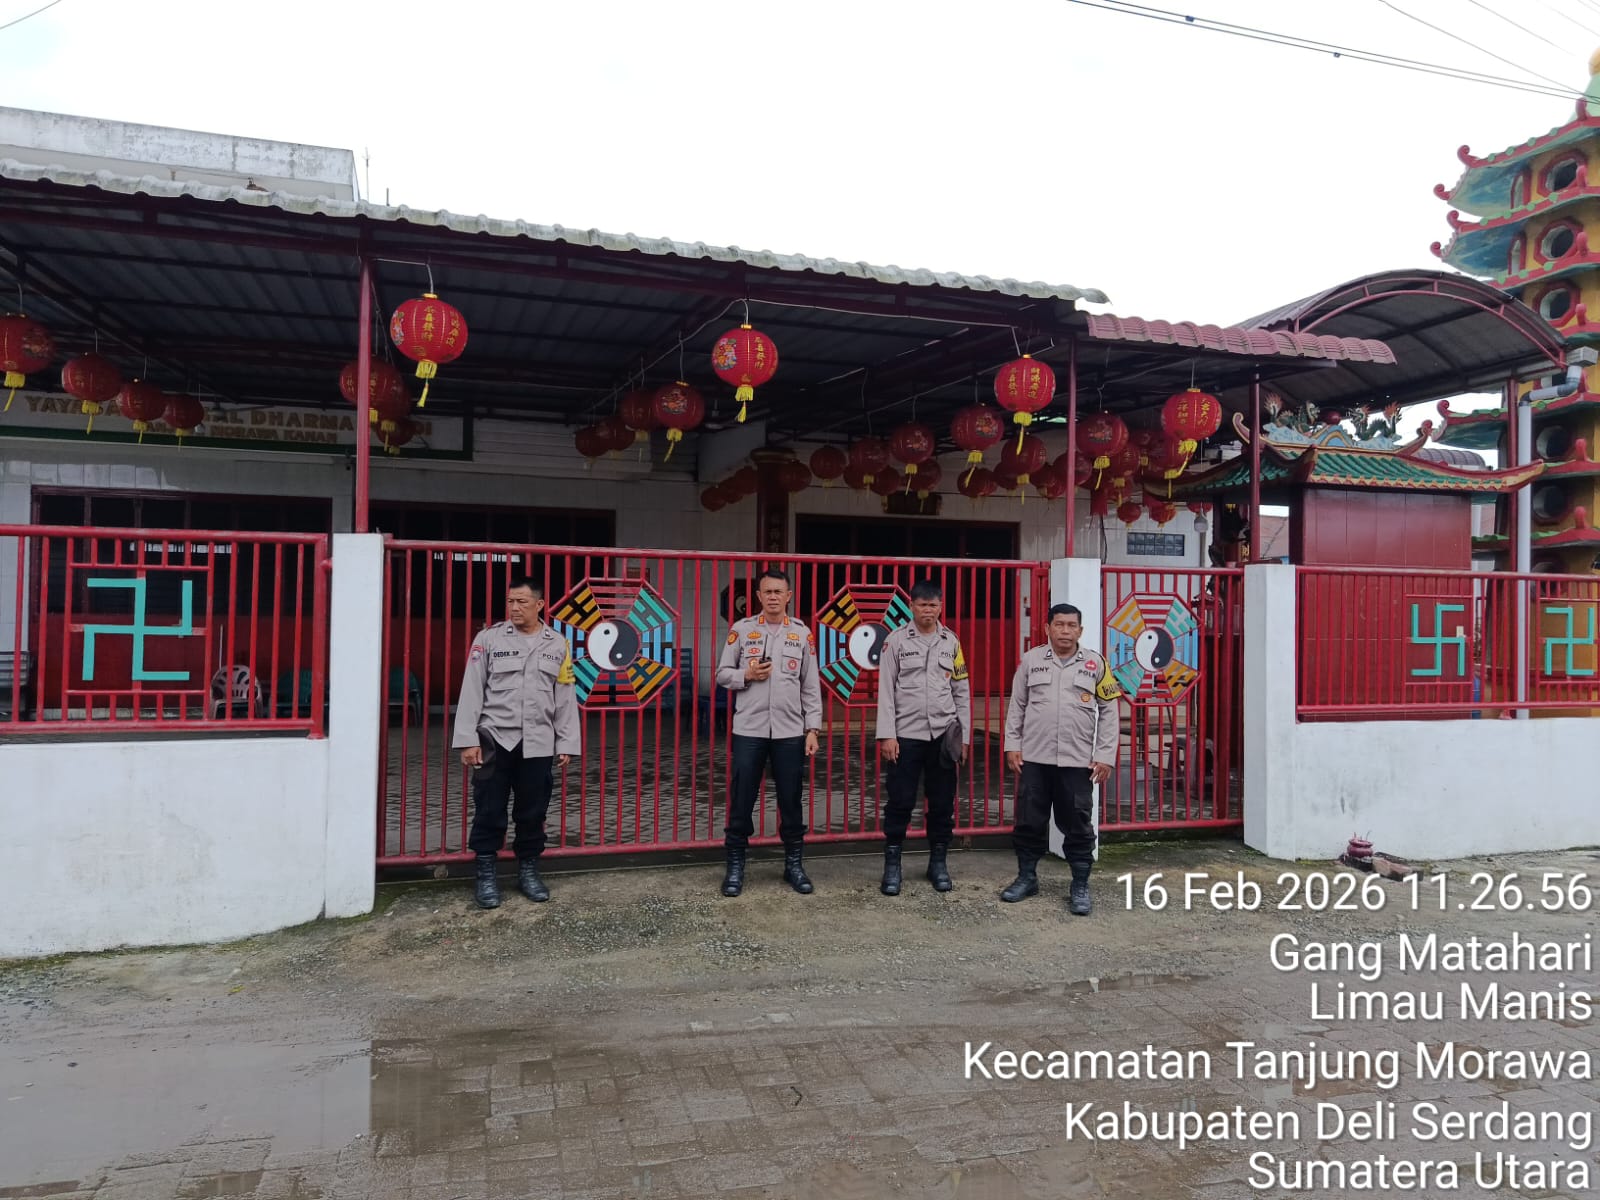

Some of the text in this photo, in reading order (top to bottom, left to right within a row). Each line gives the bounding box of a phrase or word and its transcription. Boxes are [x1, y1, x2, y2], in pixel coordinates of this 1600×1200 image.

[25, 395, 121, 416] YAYAA
[251, 410, 355, 431] DHARMA
[284, 428, 338, 444] KANAN
